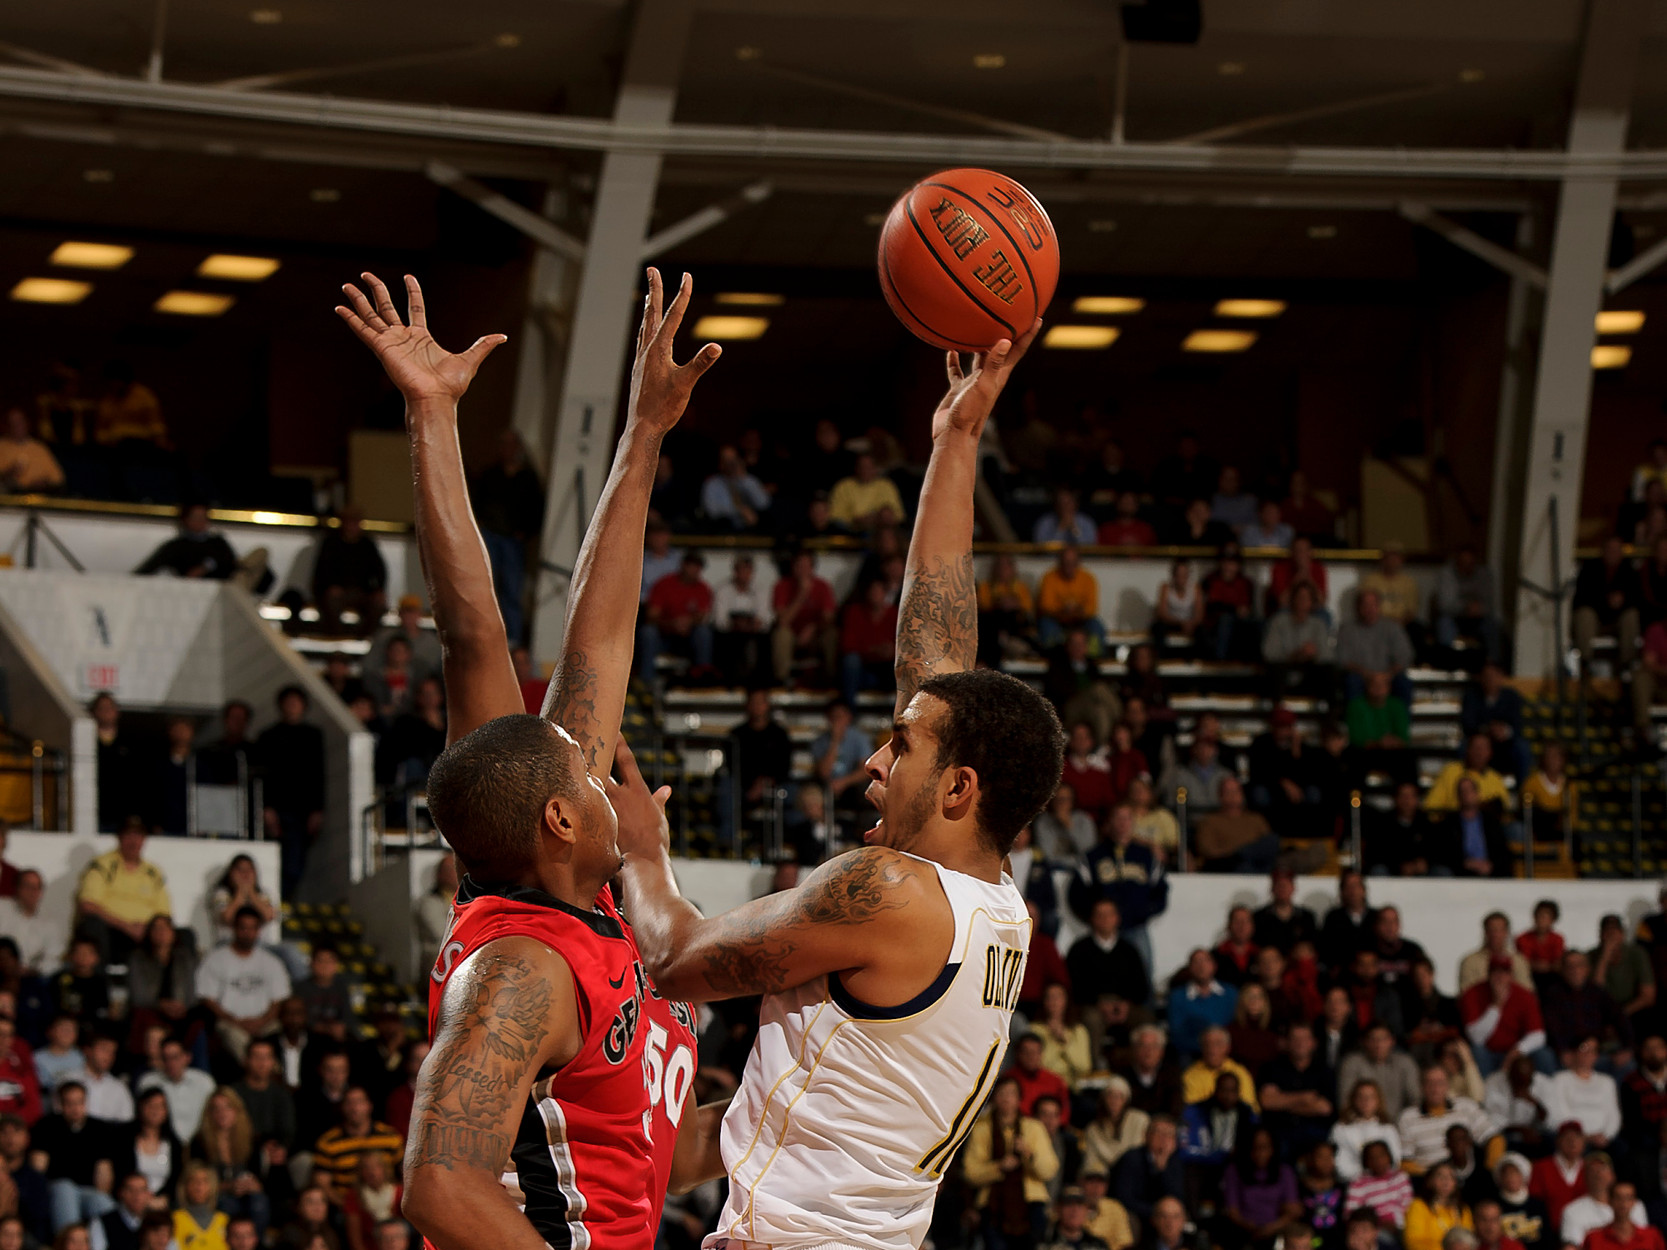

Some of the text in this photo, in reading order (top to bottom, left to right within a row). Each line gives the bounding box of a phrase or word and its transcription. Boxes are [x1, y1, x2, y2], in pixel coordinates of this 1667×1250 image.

[928, 196, 1024, 307] THE ROCK
[641, 1016, 695, 1130] 50
[913, 1038, 1001, 1179] 11
